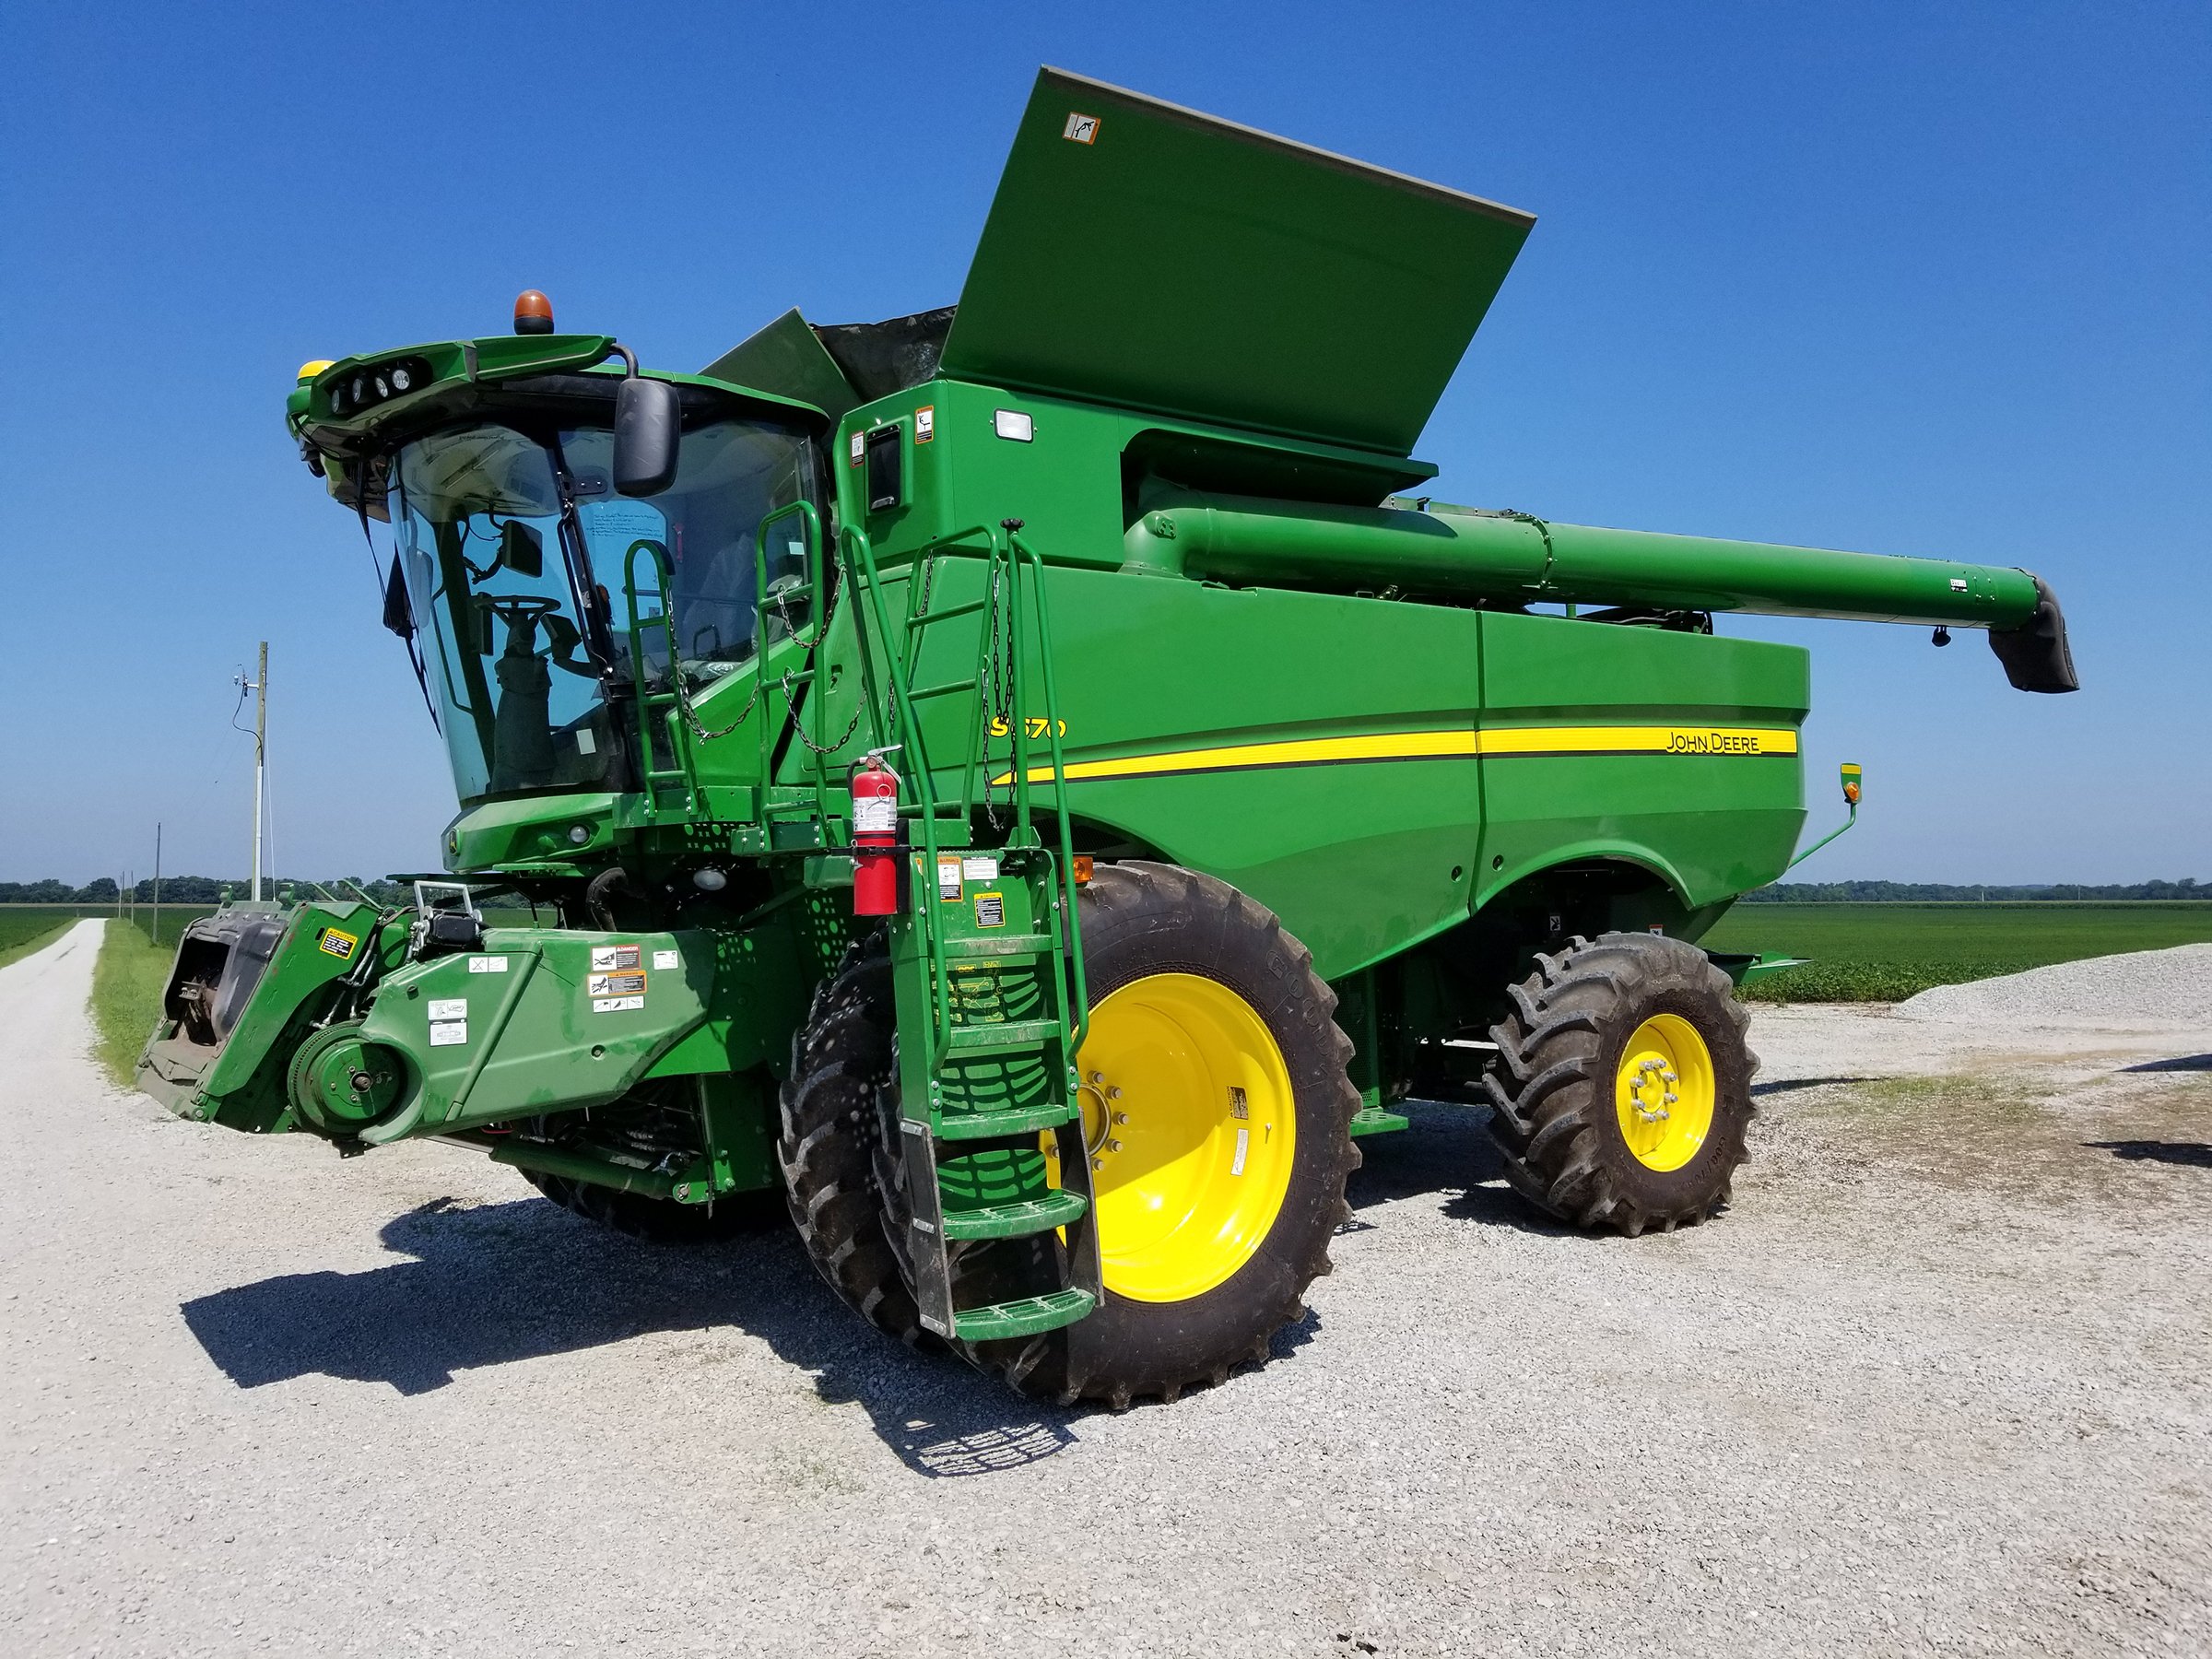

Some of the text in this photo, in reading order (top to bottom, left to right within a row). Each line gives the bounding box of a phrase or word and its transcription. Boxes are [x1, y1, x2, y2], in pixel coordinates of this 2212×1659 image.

[990, 716, 1067, 740] S70
[1666, 732, 1760, 751] JOHN DEERE
[333, 930, 357, 942] CAUTION
